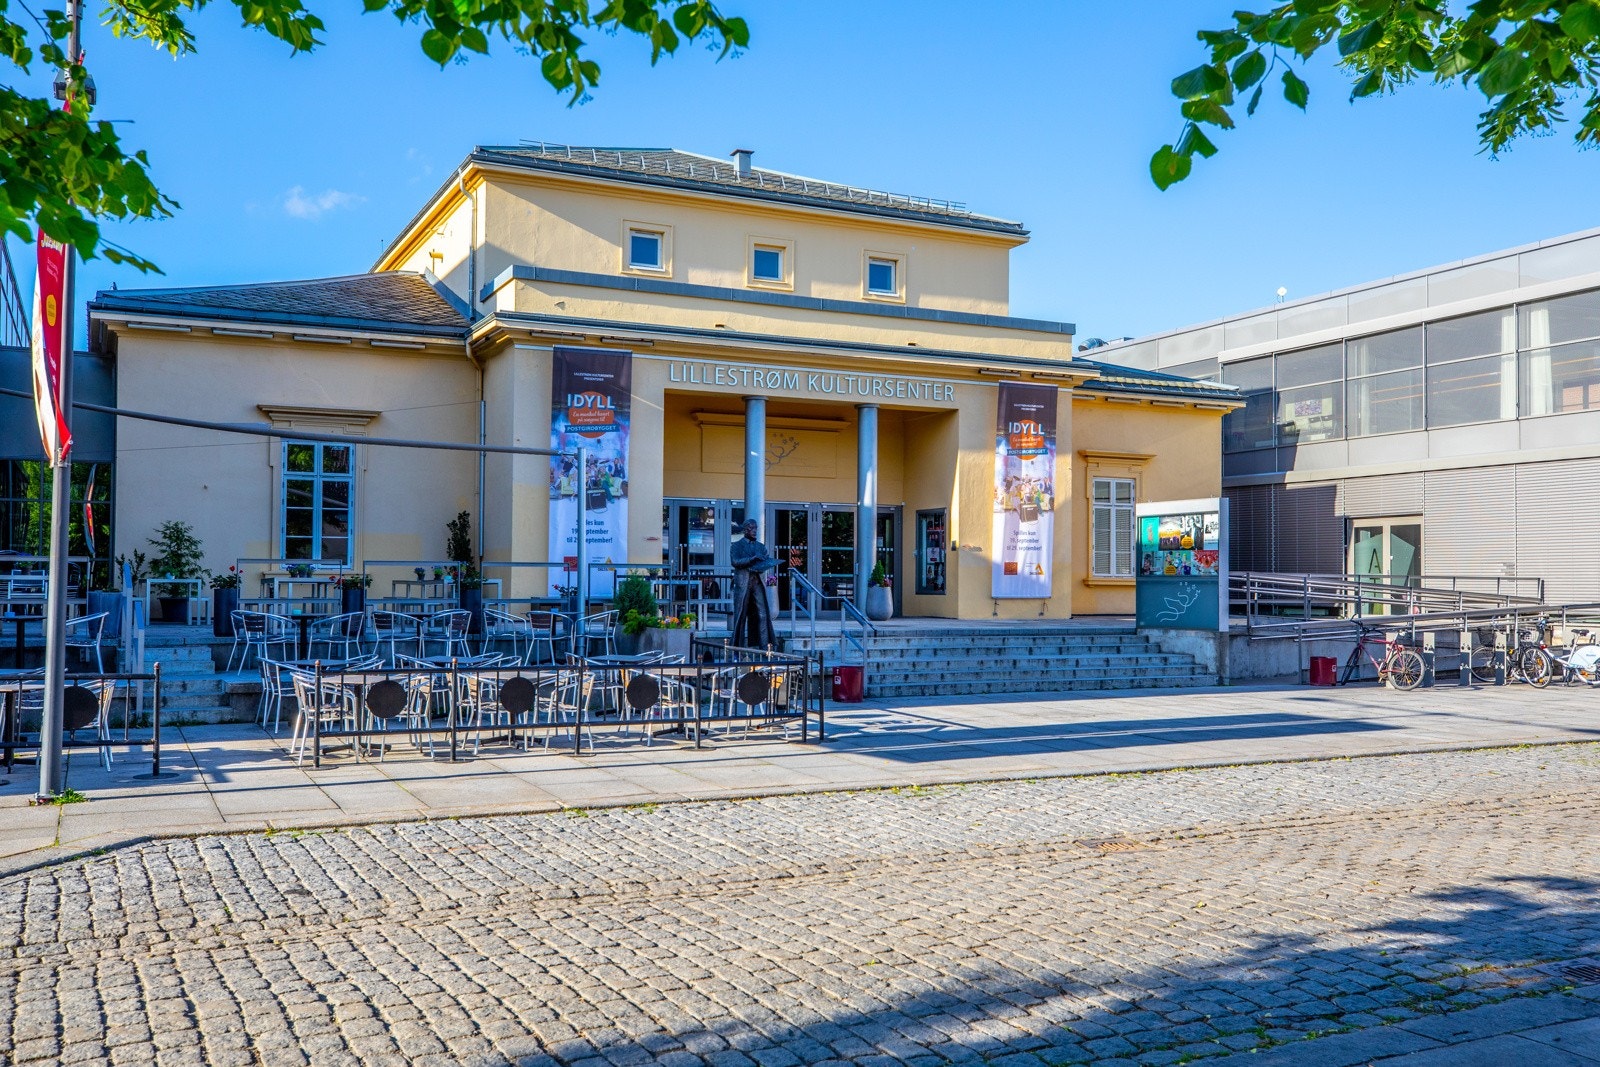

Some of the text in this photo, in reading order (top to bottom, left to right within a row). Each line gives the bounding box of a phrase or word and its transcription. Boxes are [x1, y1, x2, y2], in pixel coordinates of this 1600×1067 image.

[669, 362, 956, 402] LILLESTRØM KULTURSENTER
[567, 394, 616, 409] IDYLL
[1008, 422, 1045, 434] IDYLL
